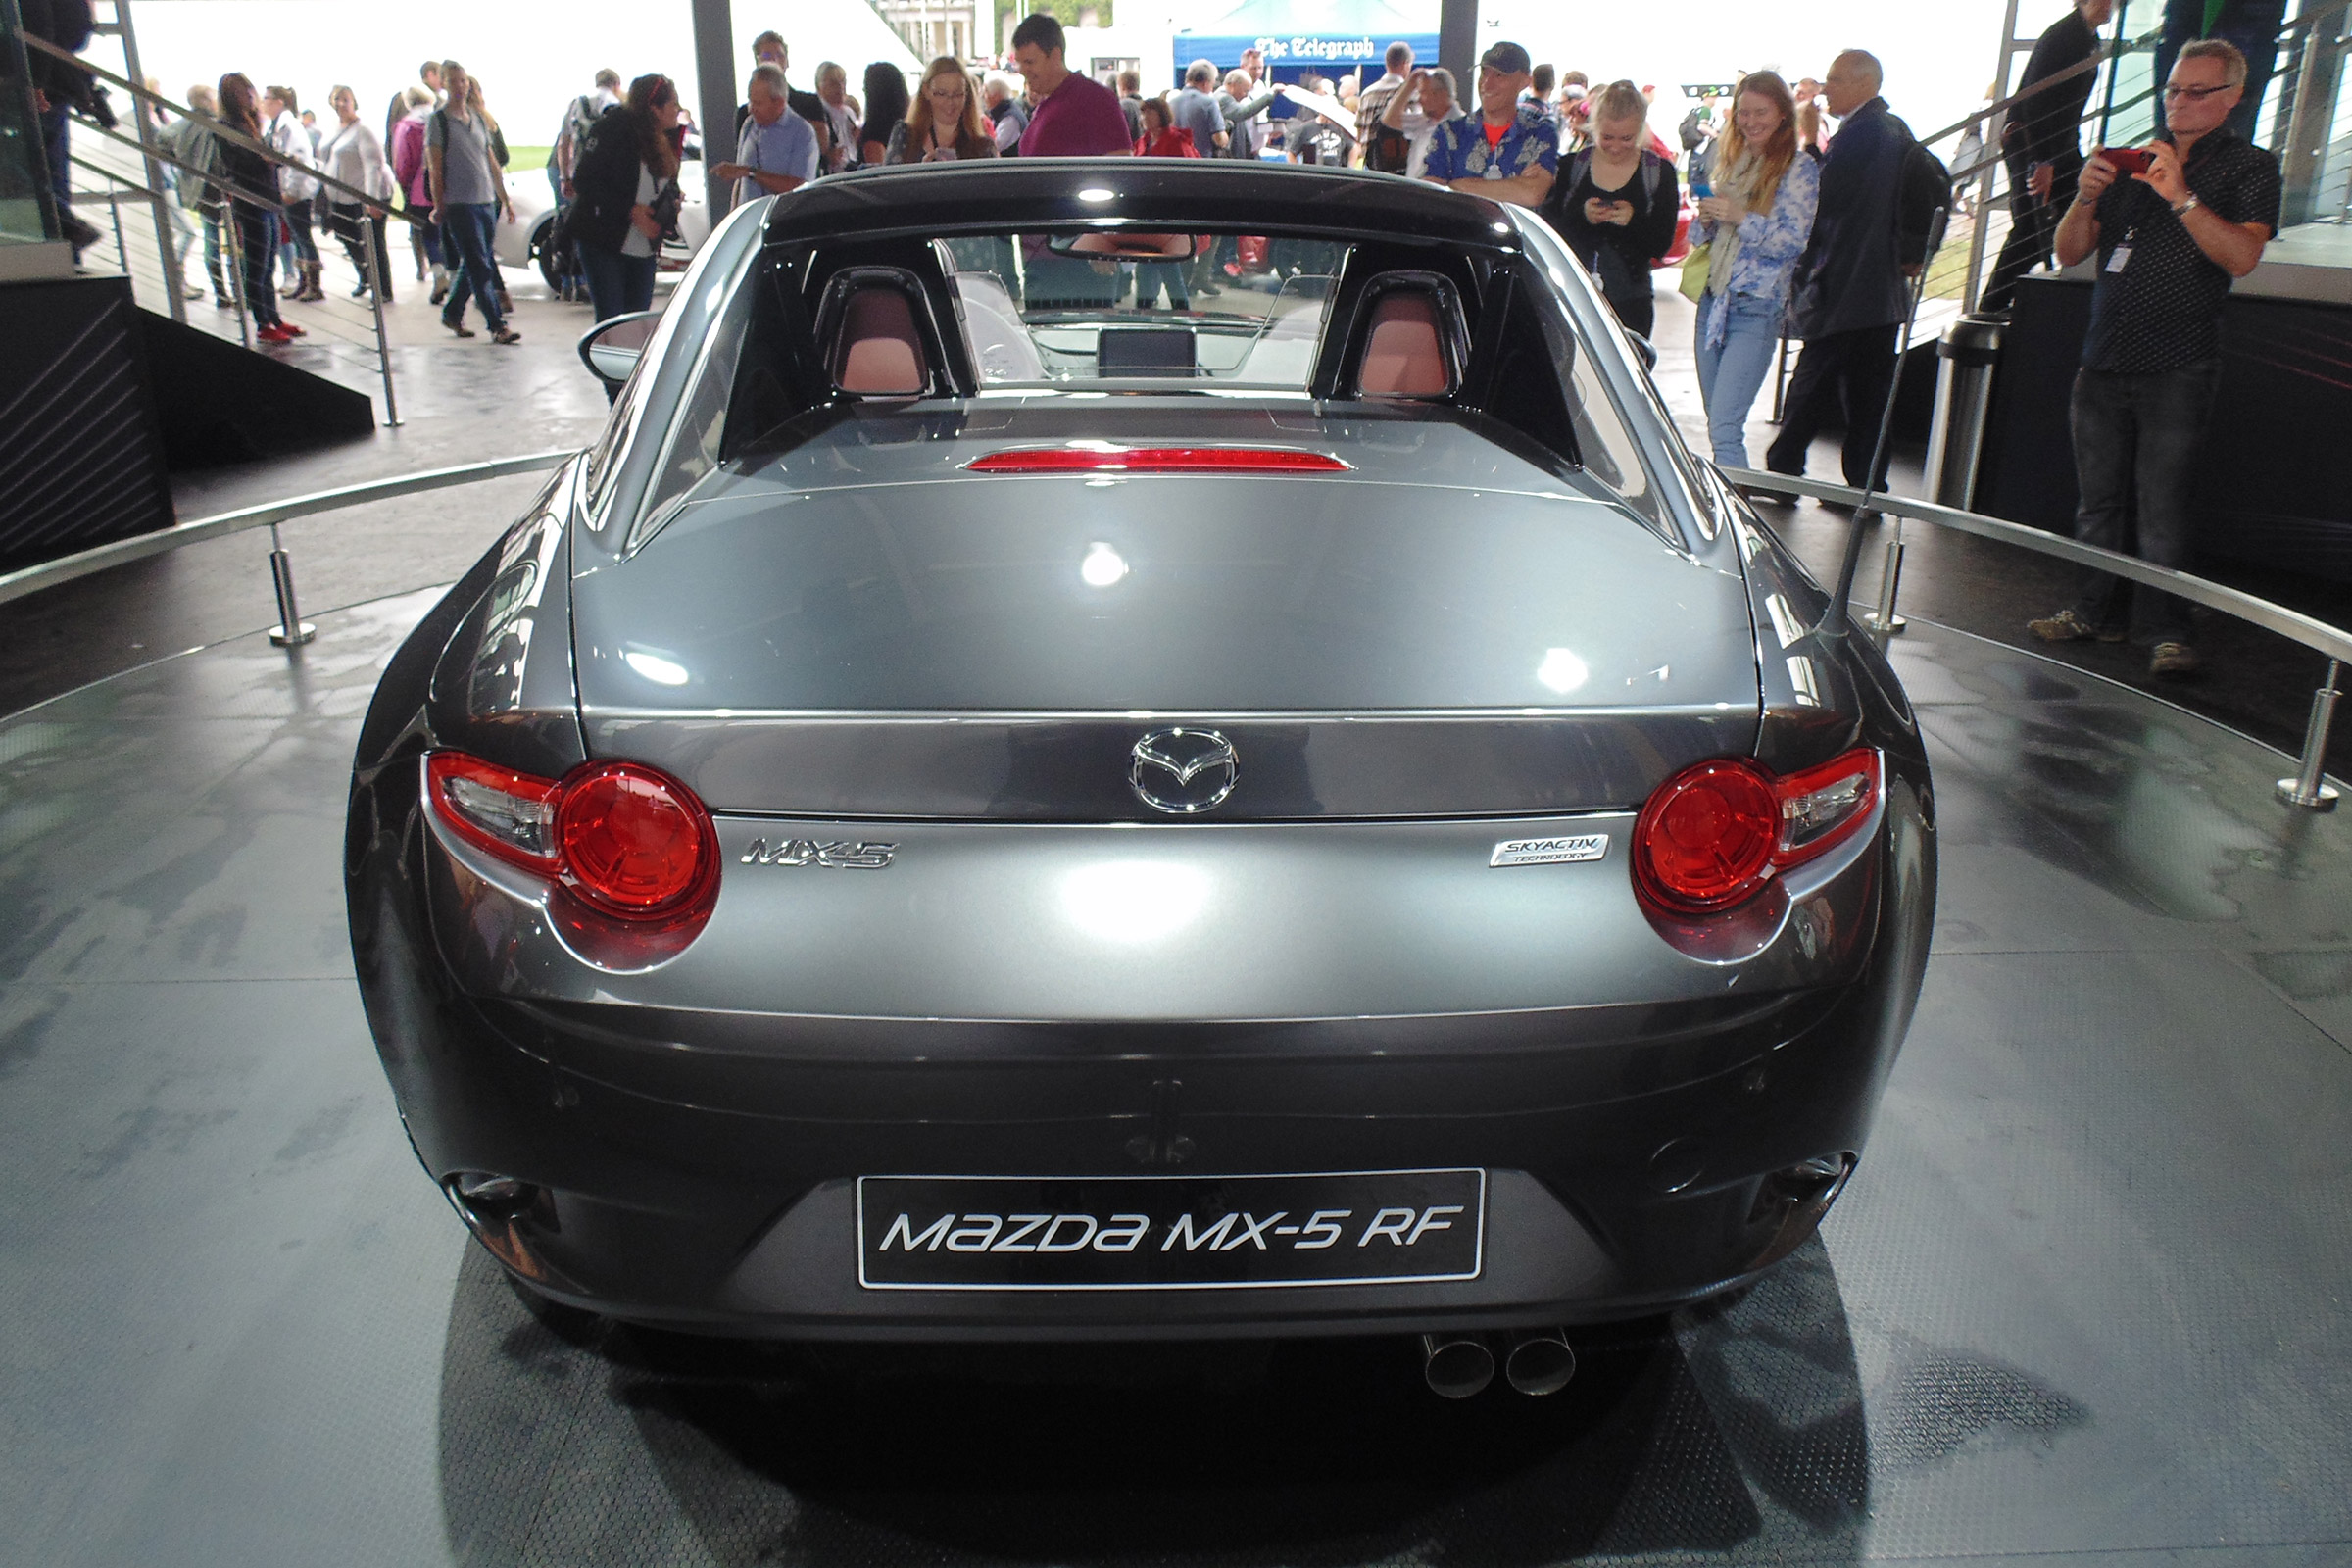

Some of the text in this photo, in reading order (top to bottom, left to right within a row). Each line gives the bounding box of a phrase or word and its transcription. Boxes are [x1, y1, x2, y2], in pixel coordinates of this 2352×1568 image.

[1254, 36, 1374, 60] The Telegraph
[740, 837, 900, 868] MX-5
[1504, 838, 1598, 853] SKYACTIV
[1512, 852, 1590, 862] TECHNOLOGY
[1160, 1209, 1352, 1251] MX-5
[1357, 1205, 1465, 1248] RF
